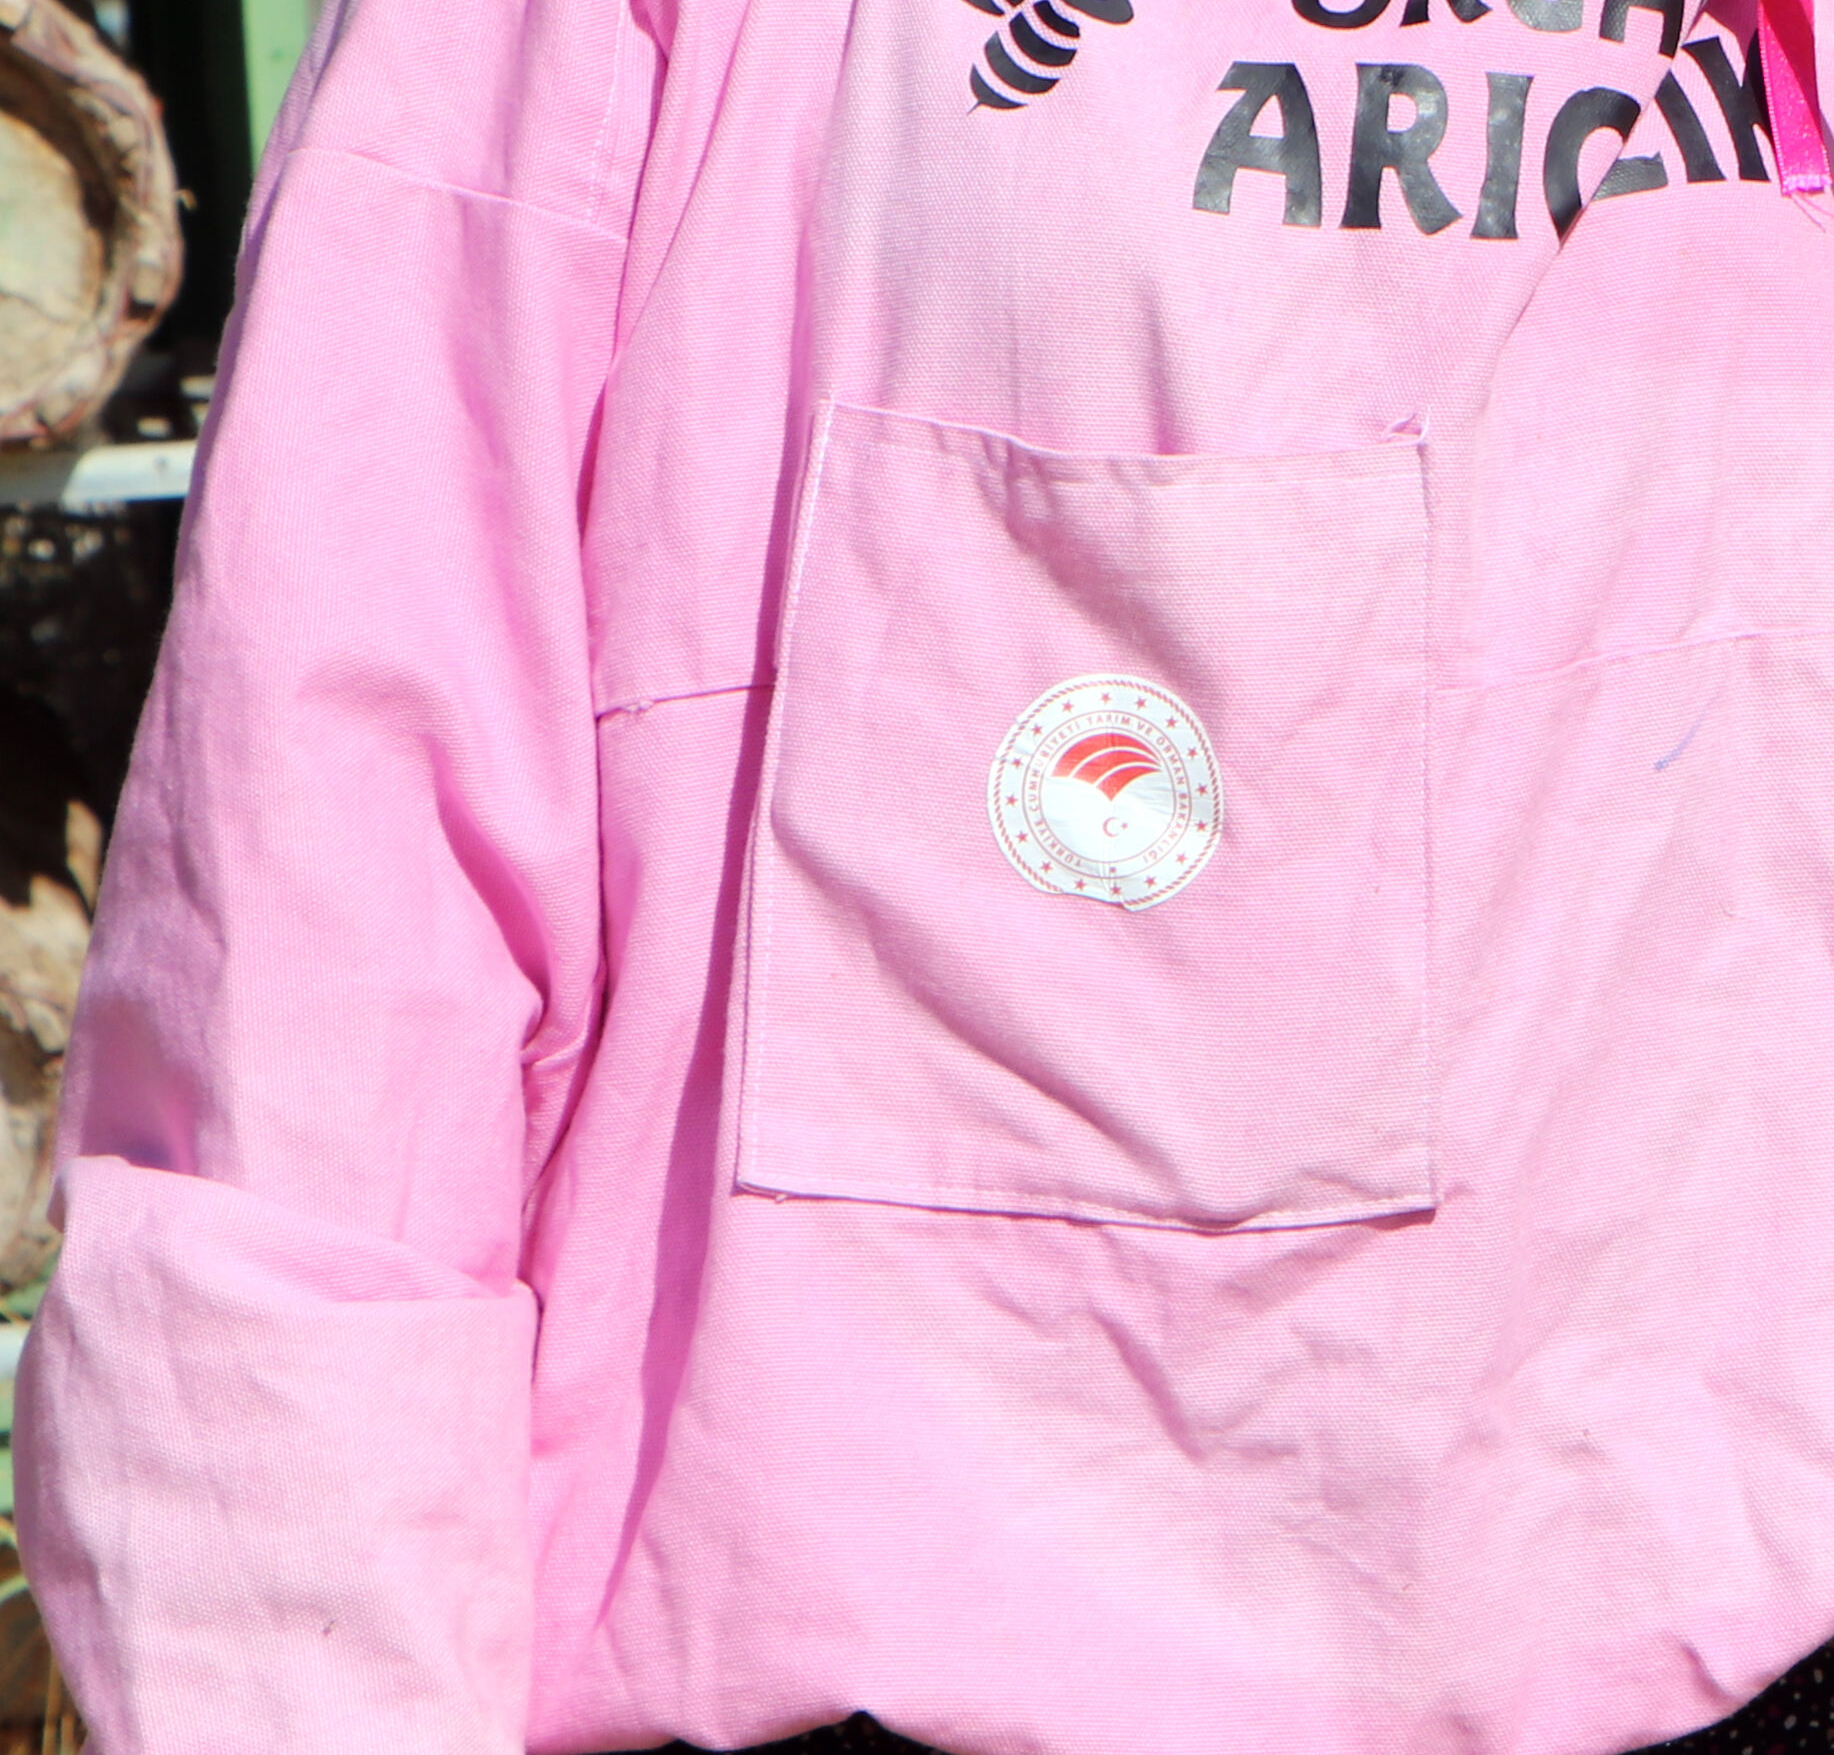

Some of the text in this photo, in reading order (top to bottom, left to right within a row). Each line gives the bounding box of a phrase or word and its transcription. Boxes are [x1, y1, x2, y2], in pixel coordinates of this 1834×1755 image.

[1086, 713, 1131, 726] TARIM
[1137, 721, 1153, 735] VE
[1156, 736, 1185, 785] ORMAN
